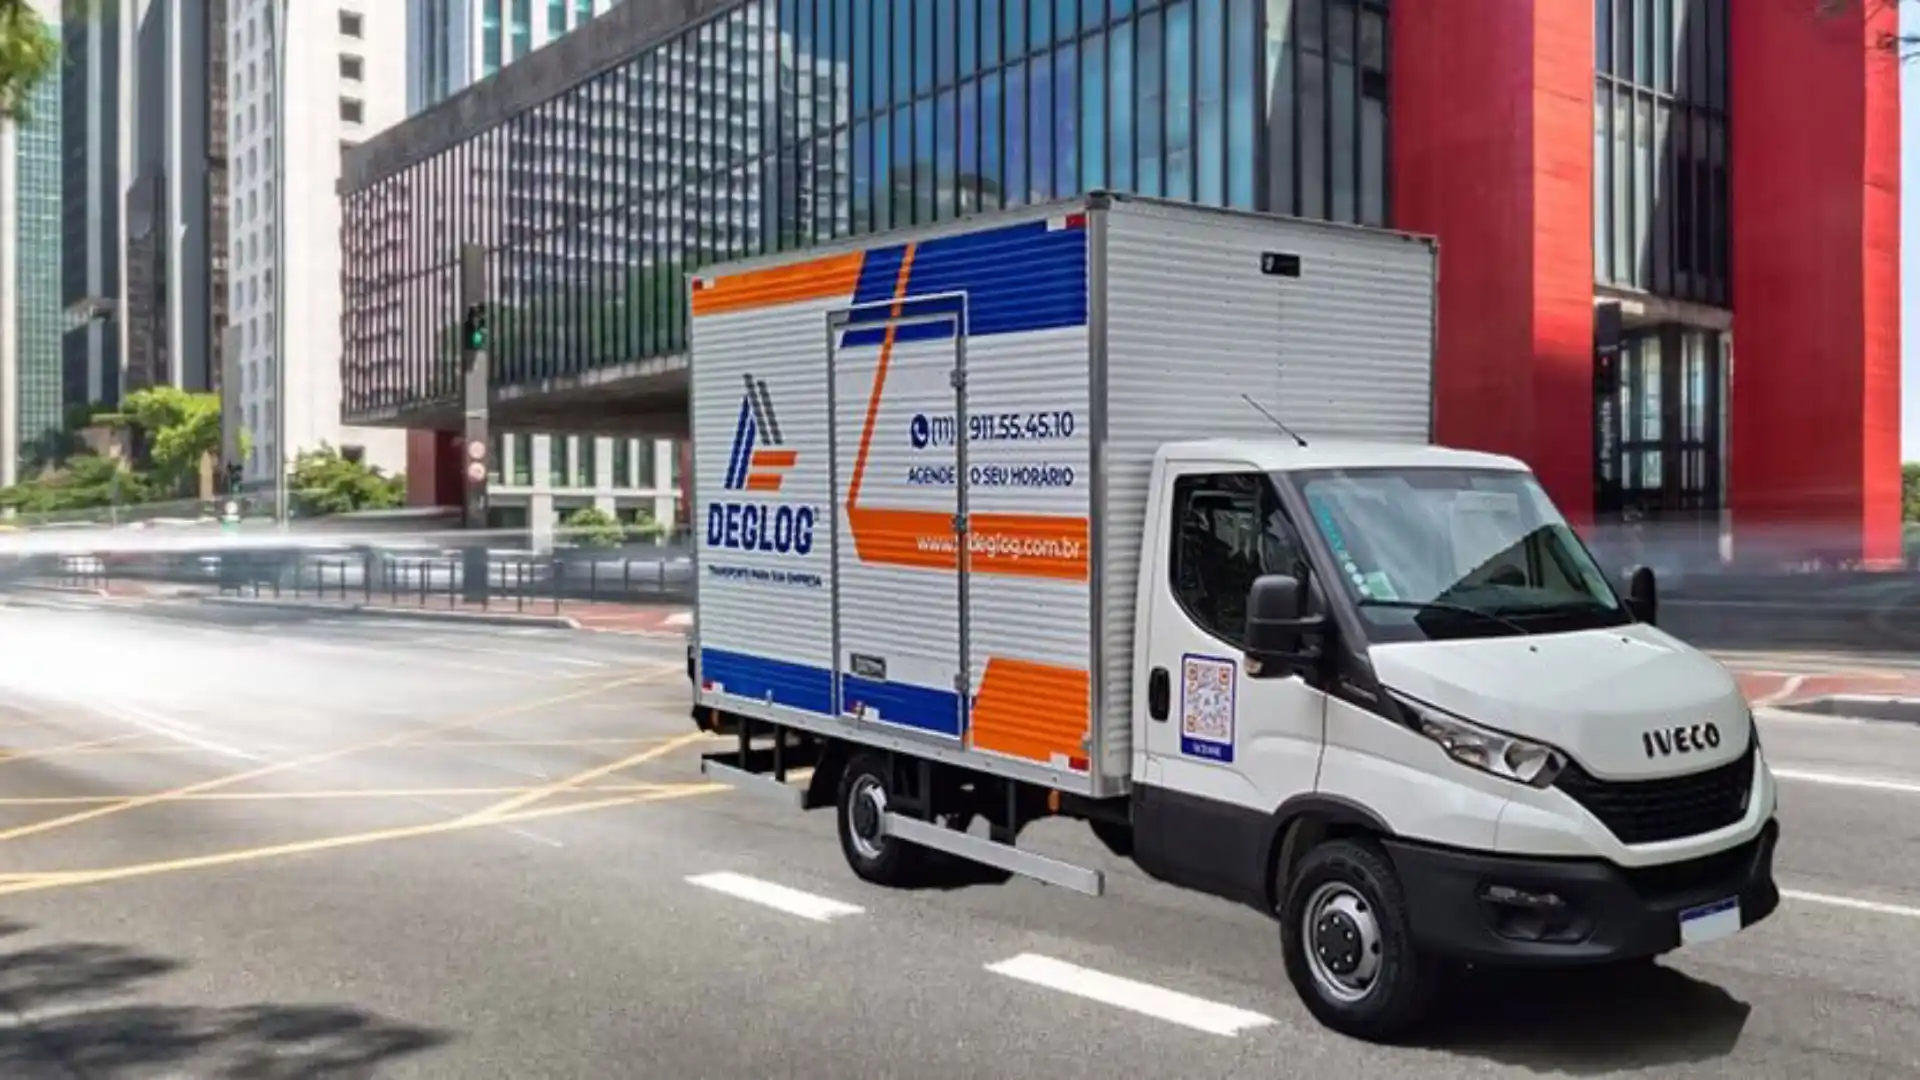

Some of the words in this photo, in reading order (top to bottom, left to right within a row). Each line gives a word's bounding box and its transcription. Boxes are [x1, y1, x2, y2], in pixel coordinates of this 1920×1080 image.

[907, 466, 955, 485] AGENDE
[983, 466, 1008, 487] SEU
[1010, 462, 1074, 487] HORÁRIO
[1642, 723, 1720, 760] IVECO
